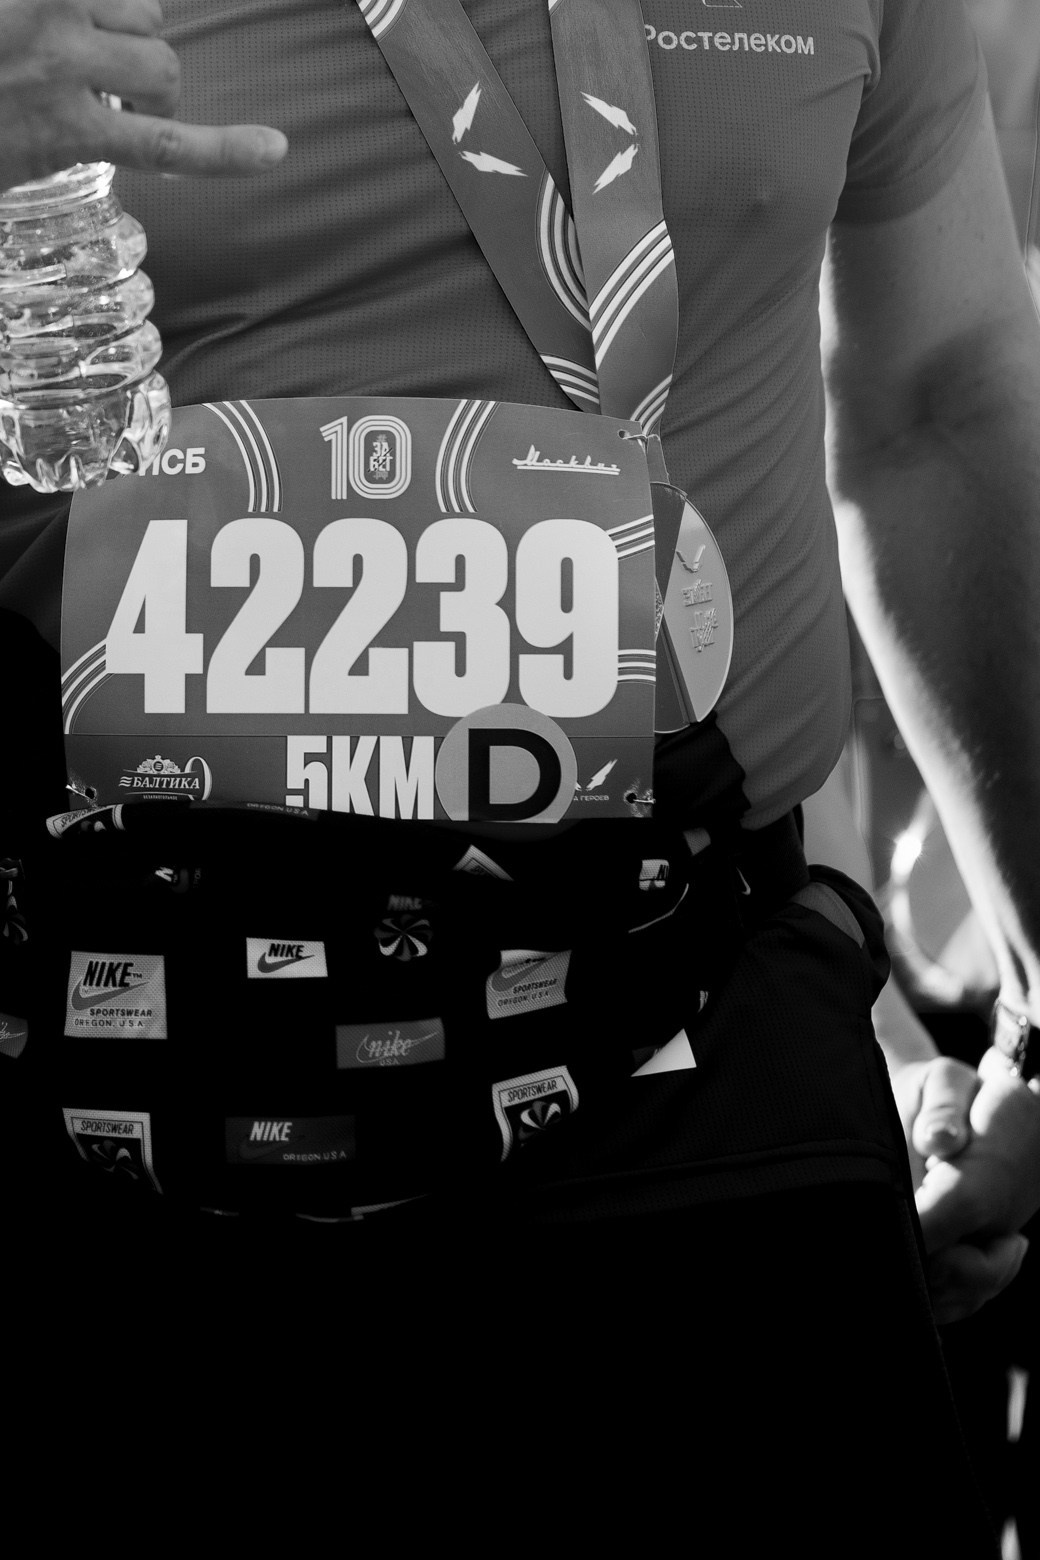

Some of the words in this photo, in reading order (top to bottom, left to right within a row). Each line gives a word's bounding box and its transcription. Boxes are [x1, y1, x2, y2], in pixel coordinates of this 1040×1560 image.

[644, 24, 815, 55] Ростелеком
[320, 415, 412, 500] 10
[106, 518, 619, 718] 42239
[132, 776, 200, 789] БАЛТИКА
[468, 728, 562, 821] D
[268, 943, 304, 959] NIKE
[83, 961, 134, 987] NIKE
[89, 1008, 153, 1017] SPORTSWEAR
[507, 1080, 558, 1103] SPORTSWEAR
[80, 1120, 135, 1135] SPORTSWEAR
[249, 1121, 293, 1142] NIKE
